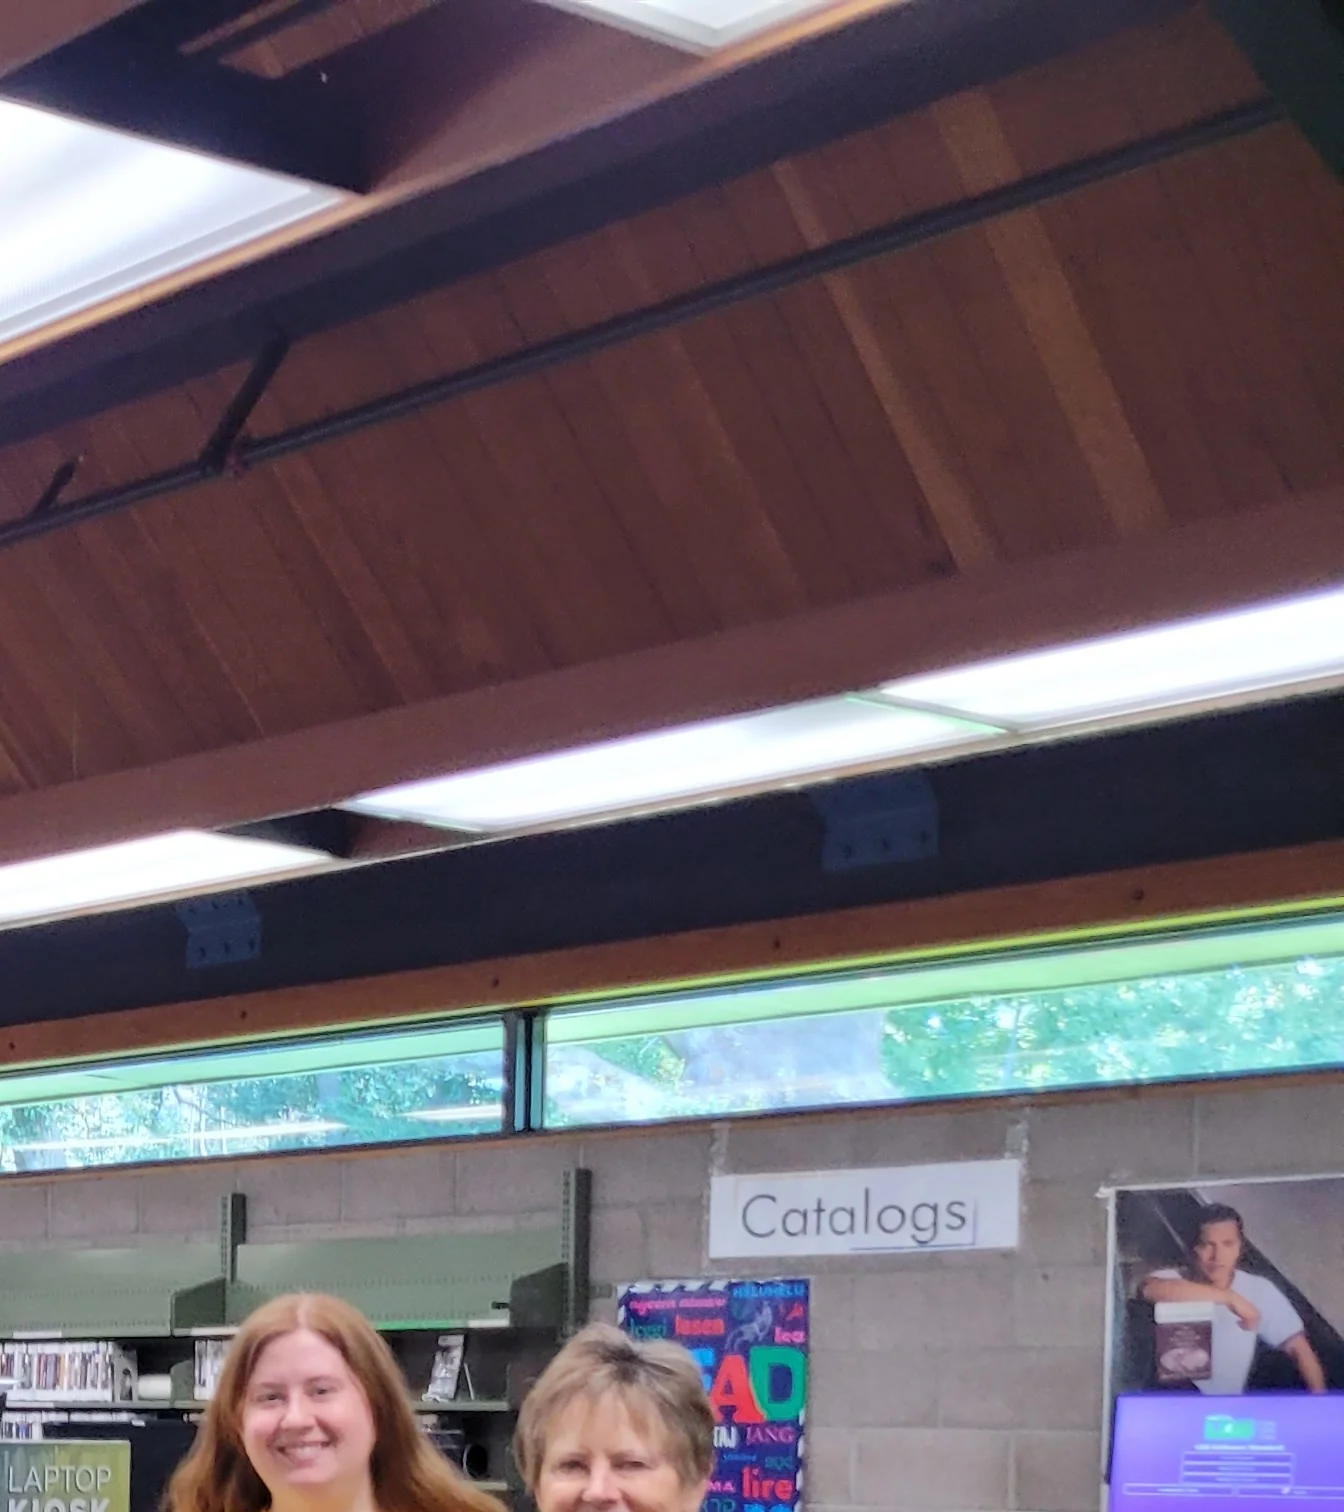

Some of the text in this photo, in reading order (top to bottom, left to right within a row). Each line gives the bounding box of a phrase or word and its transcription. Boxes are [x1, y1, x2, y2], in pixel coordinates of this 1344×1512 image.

[741, 1187, 967, 1245] Catalogs
[690, 1346, 807, 1423] AD
[8, 1465, 111, 1494] LAPTOP
[742, 1466, 793, 1500] lire
